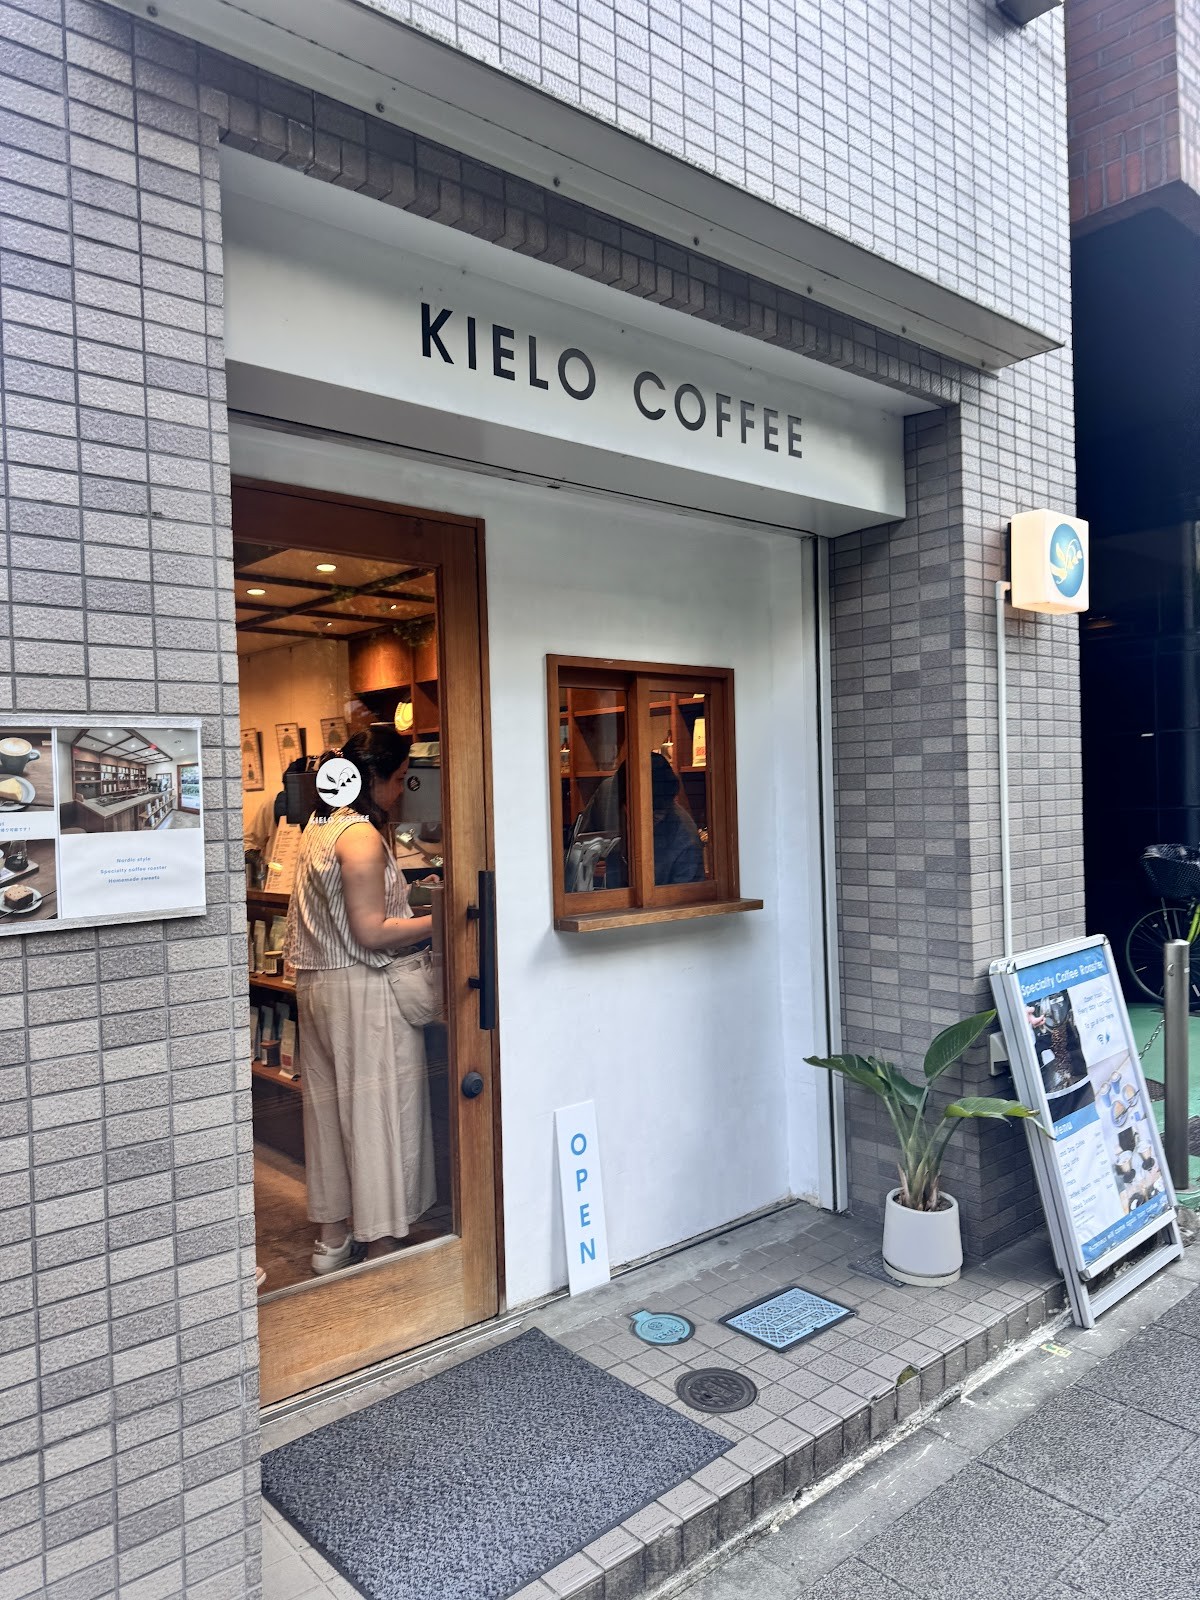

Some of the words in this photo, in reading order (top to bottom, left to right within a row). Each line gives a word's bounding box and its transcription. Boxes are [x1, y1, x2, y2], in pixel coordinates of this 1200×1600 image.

[421, 302, 596, 401] KIELO
[633, 371, 802, 459] COFFEE
[310, 816, 335, 825] KIELO
[340, 814, 370, 823] COFFEE
[1020, 976, 1055, 997] Specialty
[1055, 968, 1079, 984] Coffee
[1079, 960, 1104, 975] Roaster
[570, 1133, 596, 1265] OPEN
